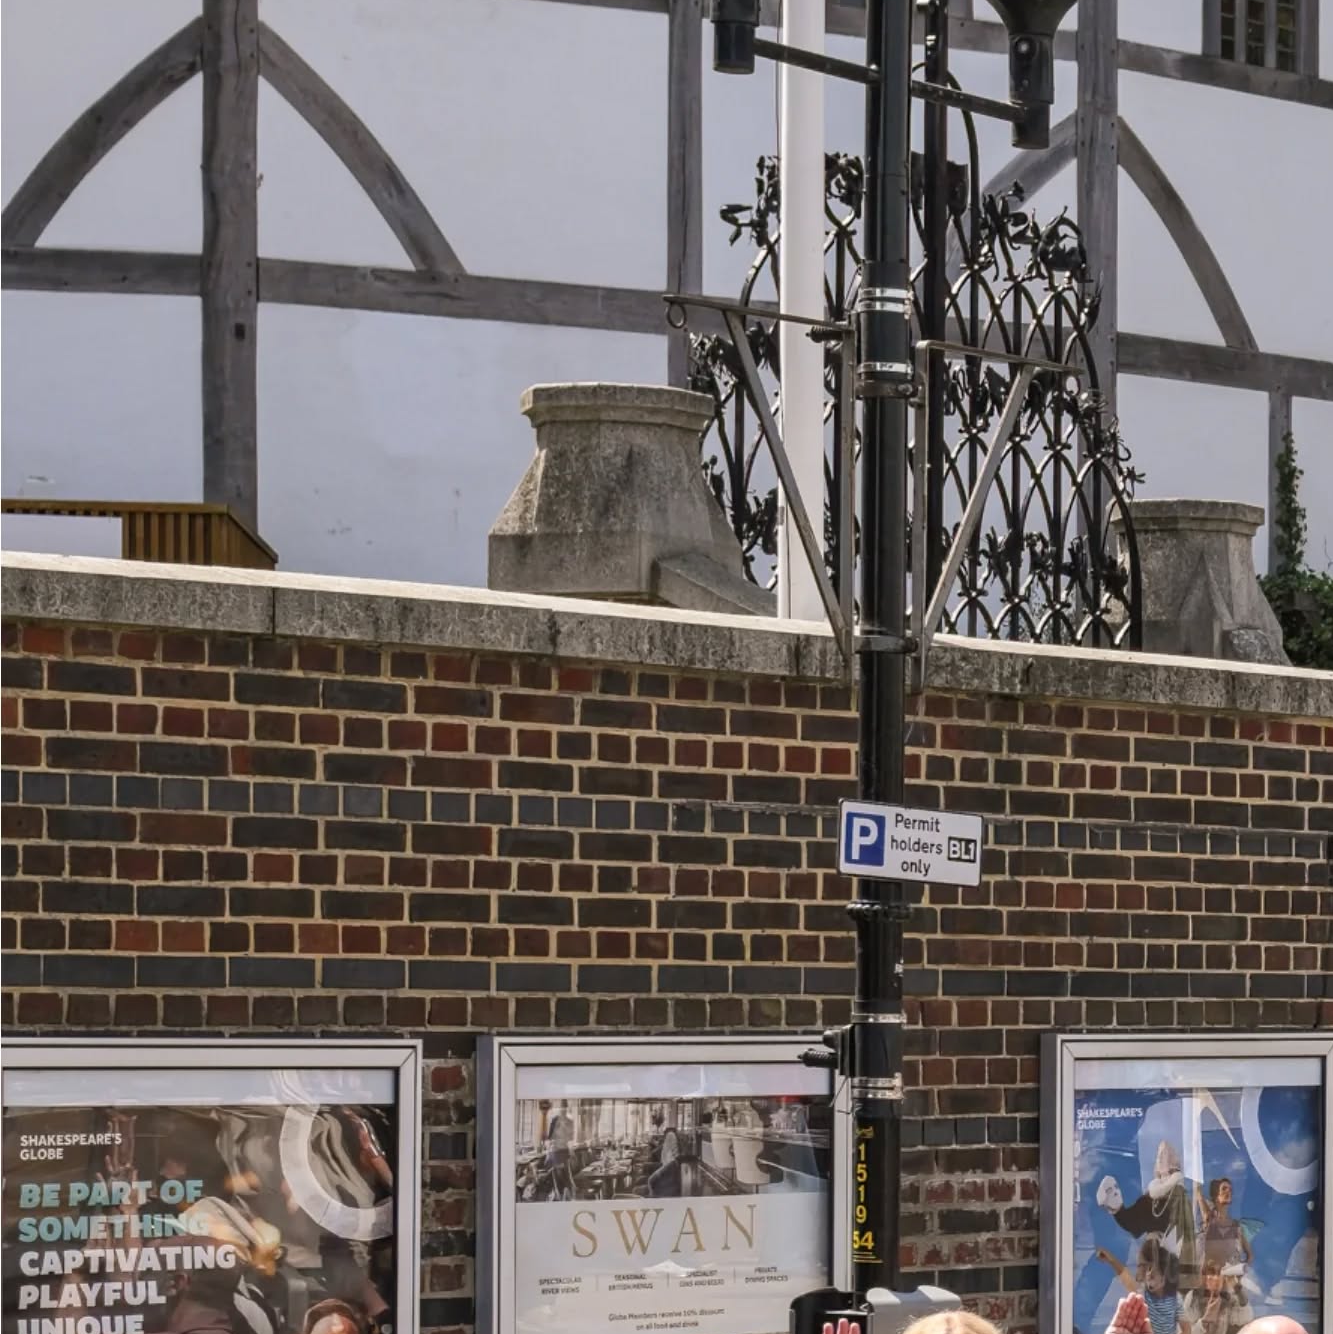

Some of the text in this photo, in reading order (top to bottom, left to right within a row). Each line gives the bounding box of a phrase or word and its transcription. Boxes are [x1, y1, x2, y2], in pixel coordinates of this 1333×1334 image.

[895, 813, 940, 833] Permit
[851, 817, 879, 860] P
[890, 835, 976, 861] holders BL1
[901, 859, 931, 877] only
[20, 1132, 123, 1147] SHAKESPEARE'S
[19, 1147, 64, 1161] GLOBE
[19, 1179, 203, 1208] BE PART OF
[18, 1214, 209, 1242] SOMETHING
[571, 1204, 757, 1258] SWAN
[19, 1244, 236, 1276] CAPTIVATING
[18, 1280, 167, 1310] PLAYFUL
